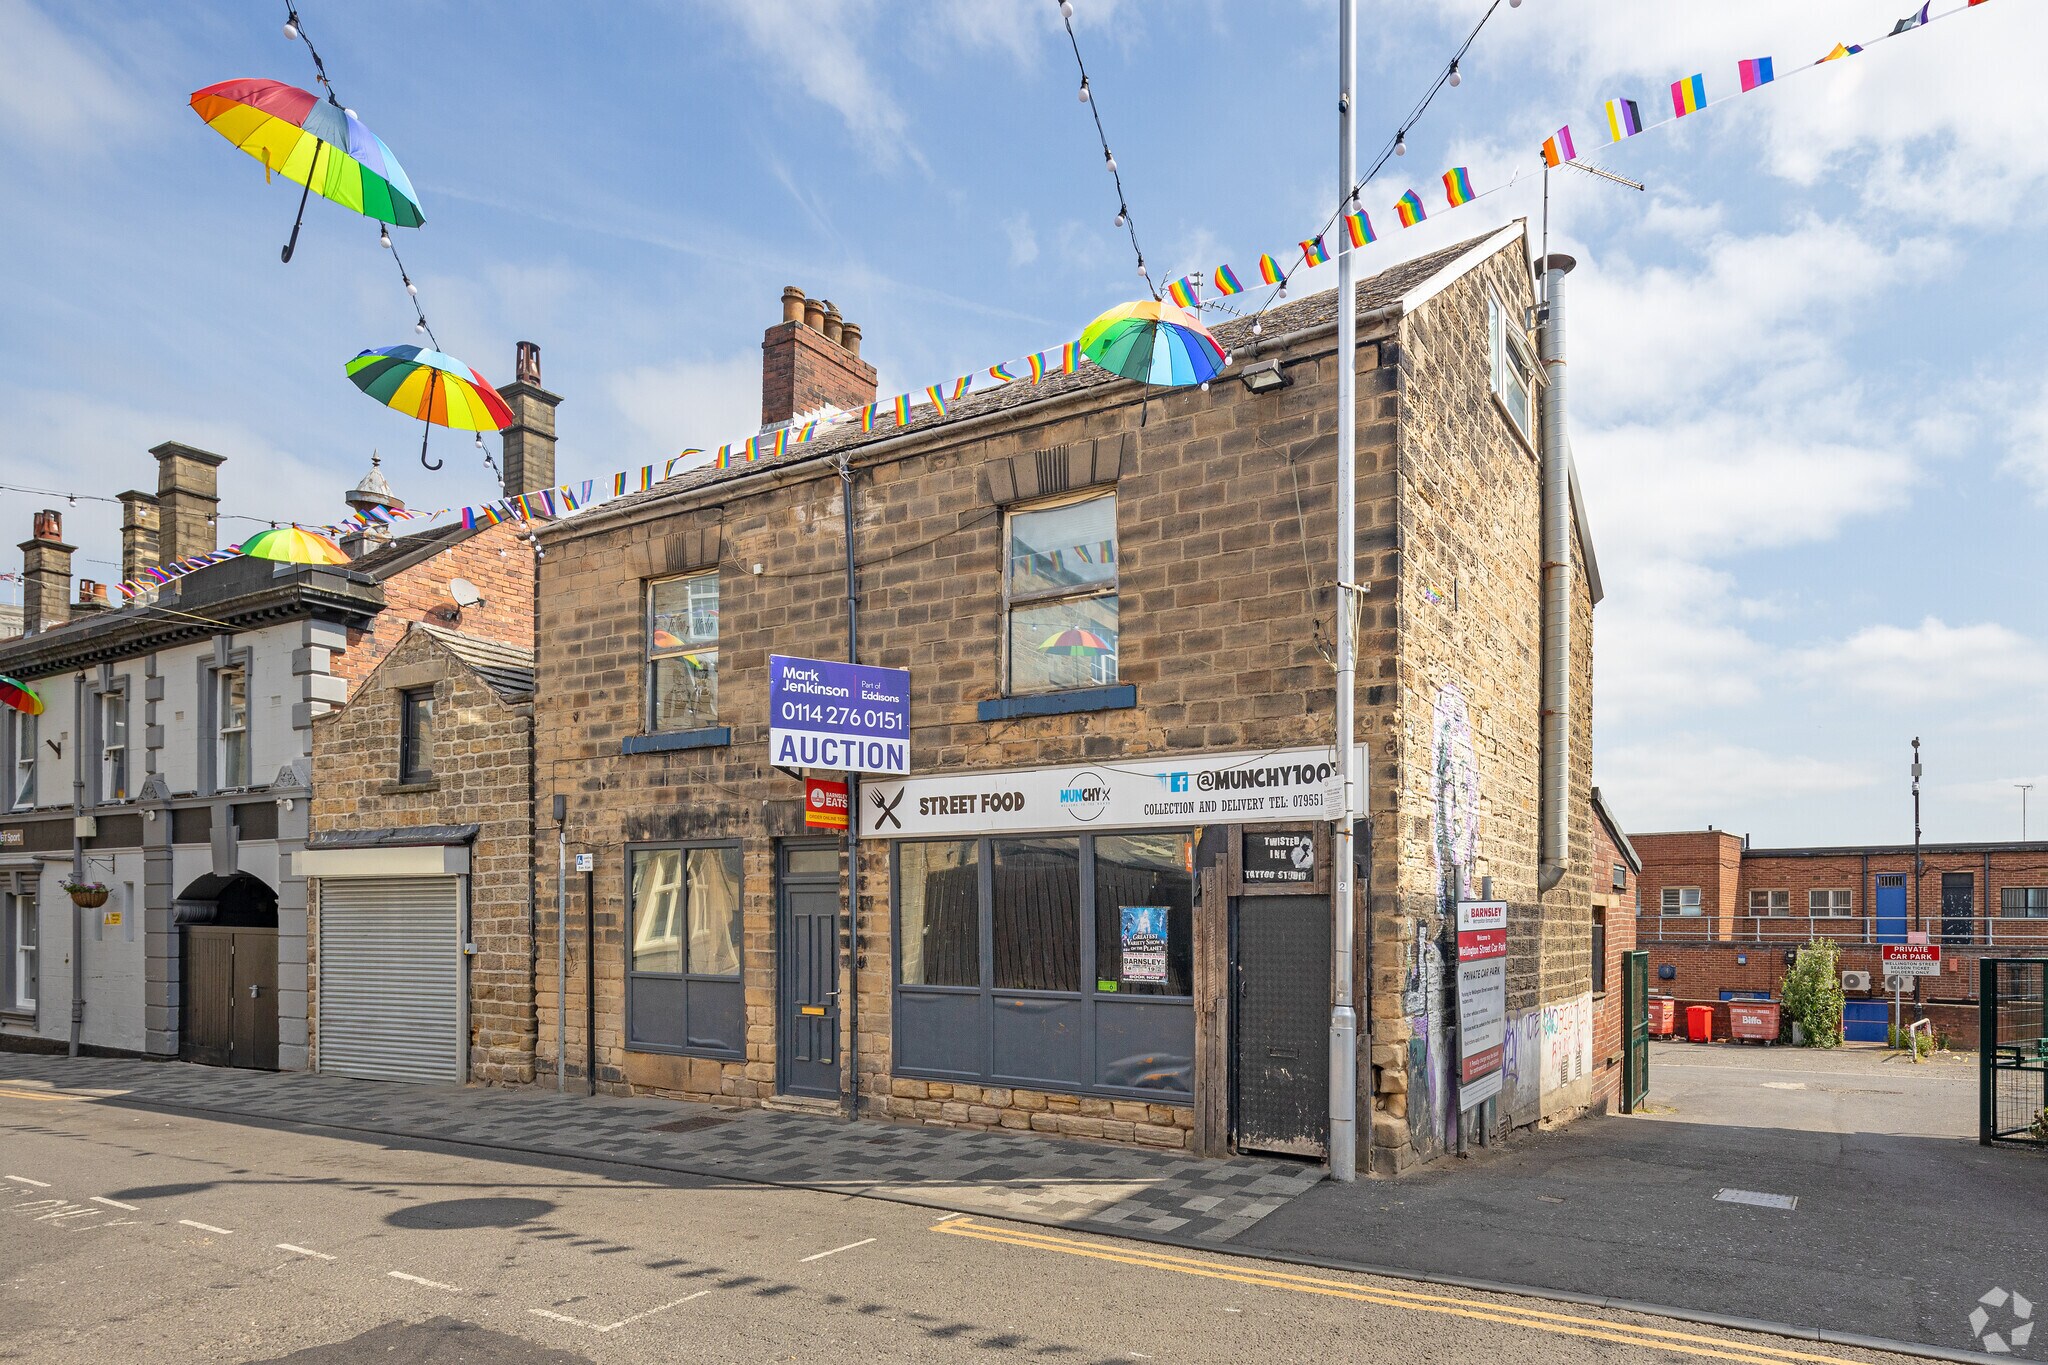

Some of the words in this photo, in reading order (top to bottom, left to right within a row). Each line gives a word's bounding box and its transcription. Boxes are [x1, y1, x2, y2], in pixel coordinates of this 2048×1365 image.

[782, 666, 819, 682] Mark
[782, 681, 849, 698] Jenkinson
[861, 680, 874, 689] Part
[874, 682, 882, 690] of
[861, 691, 900, 703] Eddisons
[782, 701, 822, 723] 0114
[826, 706, 861, 726] 276
[864, 710, 902, 730] 0151
[778, 734, 904, 771] AUCTION
[1060, 787, 1101, 803] MUNCHY
[825, 798, 848, 808] EATS
[919, 794, 977, 816] STREET
[981, 791, 1026, 813] FOOD
[1144, 801, 1194, 816] COLLECTION
[1198, 800, 1217, 813] AND
[1221, 796, 1264, 812] DELIVERY
[1268, 795, 1289, 809] TEL:
[1293, 793, 1323, 807] 079551
[8, 833, 20, 842] Sport
[1264, 836, 1300, 847] TWISTED
[1269, 849, 1287, 860] INK
[1244, 870, 1275, 879] TATTOO
[1277, 870, 1306, 880] STUDIO
[1339, 882, 1346, 890] 2
[1470, 907, 1502, 918] BARNSLEY
[1459, 945, 1478, 957] Wellington
[1480, 944, 1491, 954] Street
[1124, 958, 1162, 966] BARNSLEY
[1463, 970, 1480, 981] PRIVATE
[1481, 968, 1490, 978] CAR
[1490, 966, 1500, 976] PARK
[1742, 1016, 1762, 1024] Biffa
